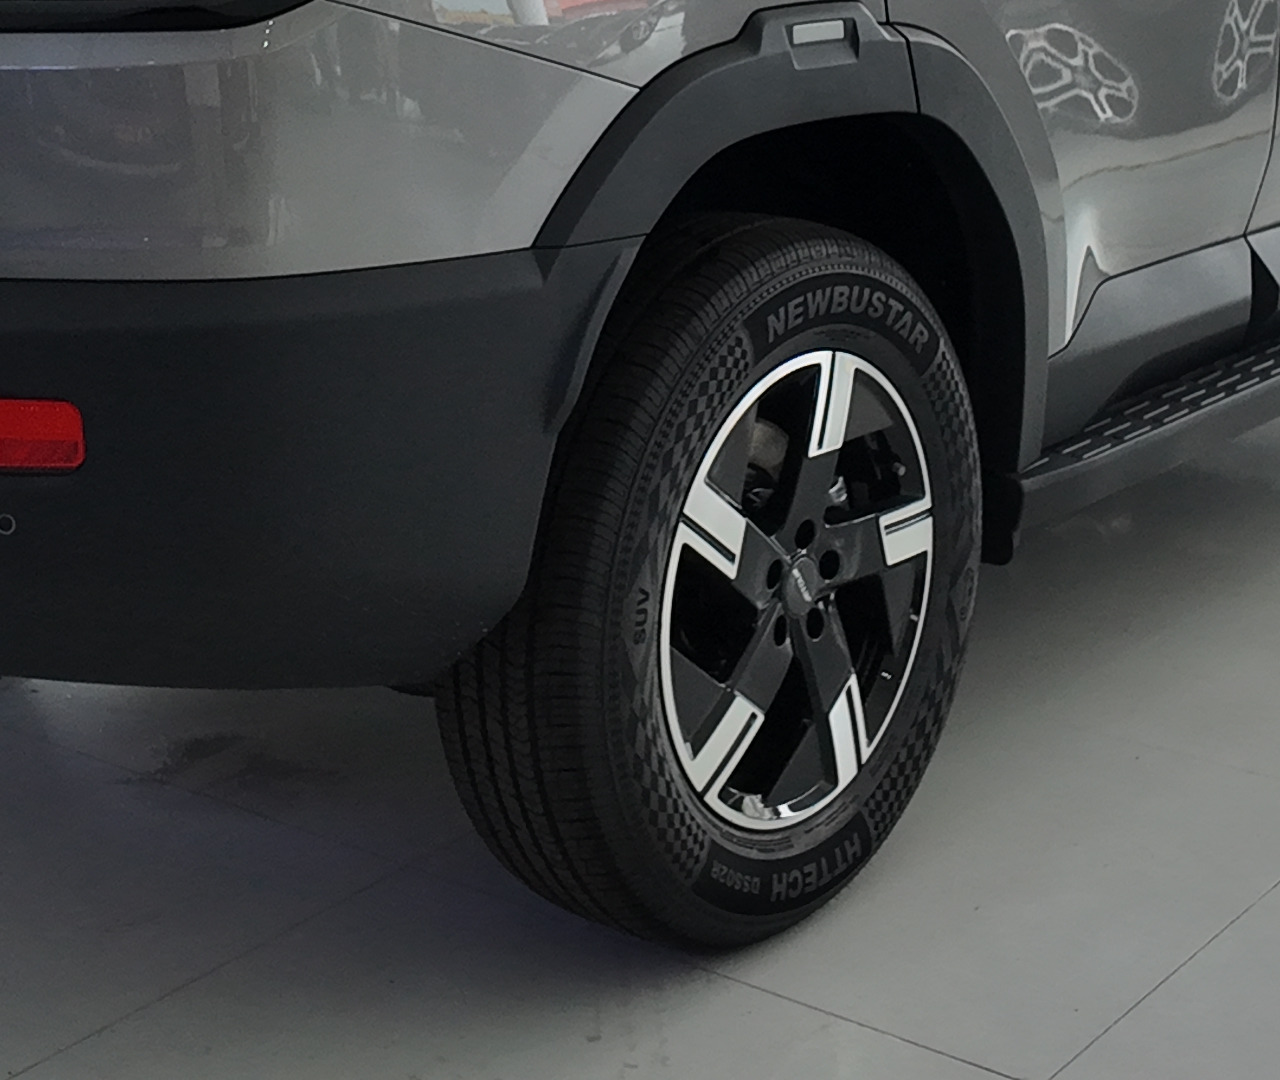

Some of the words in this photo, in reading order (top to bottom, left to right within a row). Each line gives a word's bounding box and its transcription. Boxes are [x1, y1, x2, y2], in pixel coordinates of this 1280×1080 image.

[766, 285, 929, 354] NEWBUSTAR
[633, 587, 650, 645] SUV
[770, 832, 862, 902] HTTECH
